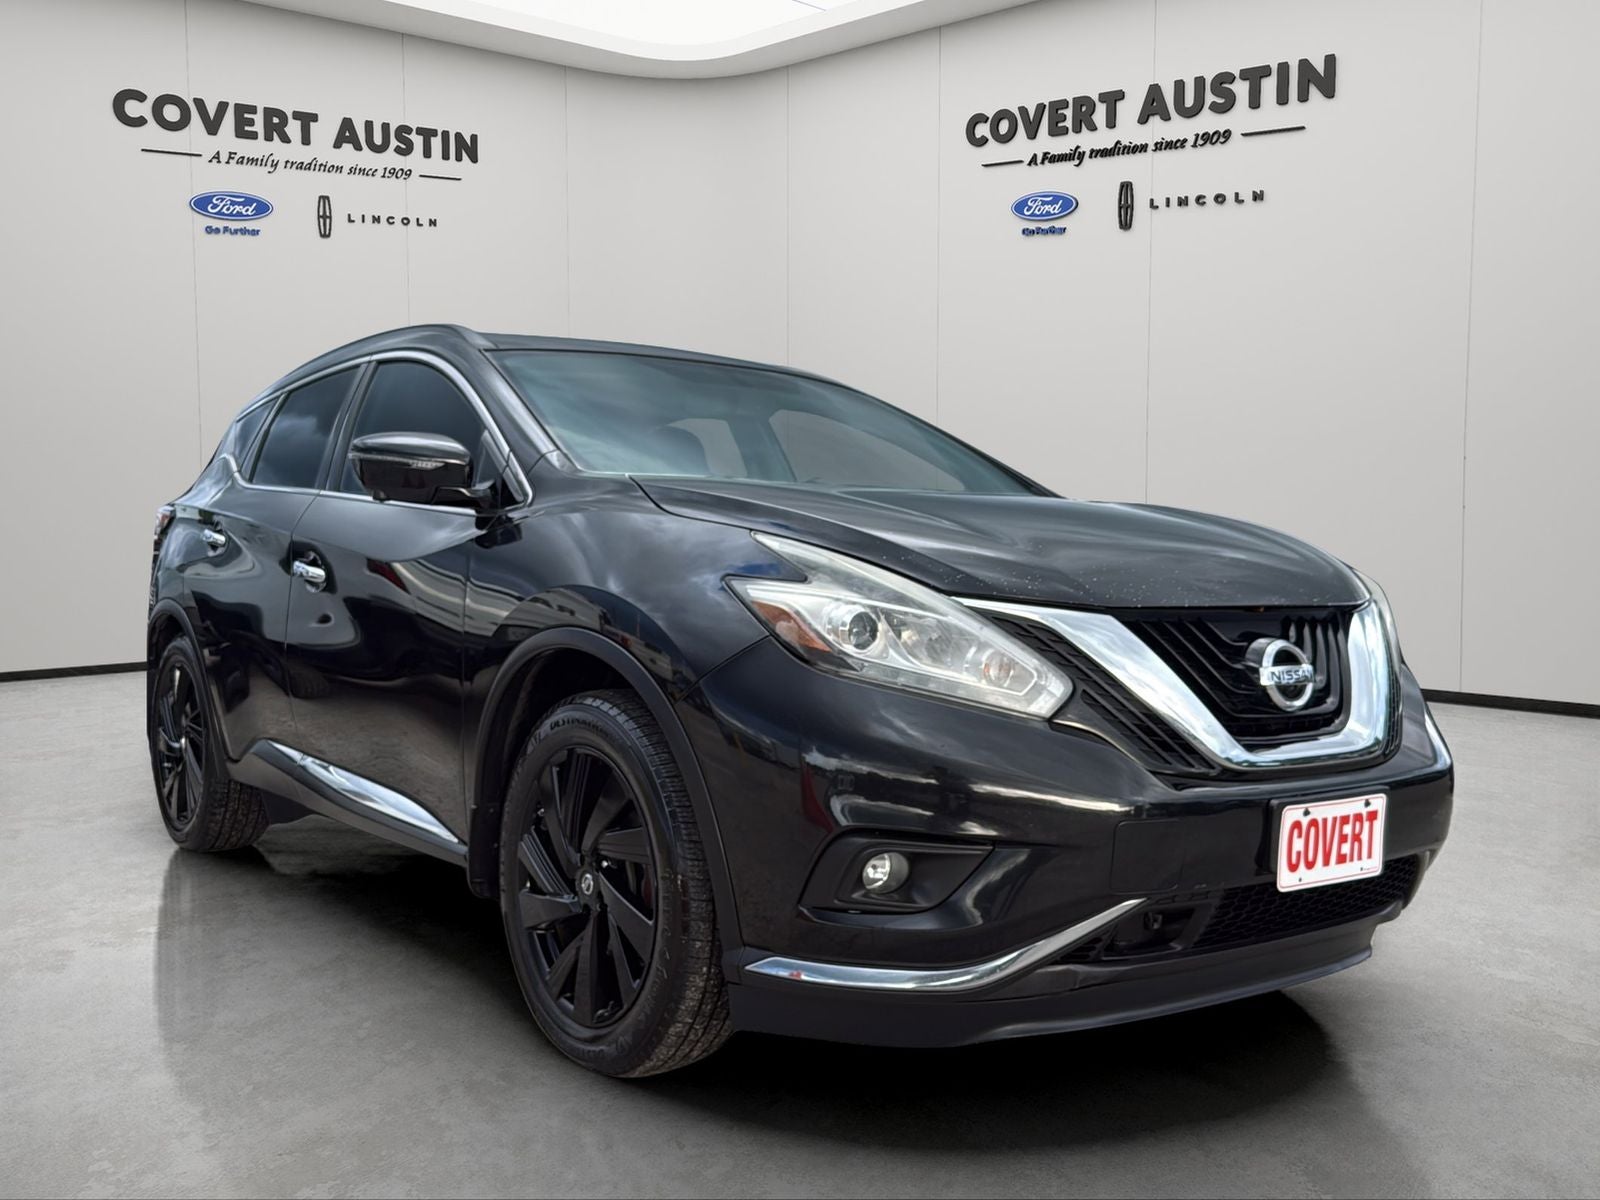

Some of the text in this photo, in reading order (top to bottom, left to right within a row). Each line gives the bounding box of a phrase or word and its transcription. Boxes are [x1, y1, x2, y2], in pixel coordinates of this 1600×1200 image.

[965, 53, 1337, 148] COVERT AUSTIN
[112, 88, 479, 164] COVERT AUSTIN
[1027, 128, 1232, 168] A Family tradition since 1909
[208, 150, 413, 180] A Family tradition since 1909
[207, 195, 257, 216] Ford
[1023, 196, 1063, 216] Ford
[1149, 190, 1265, 210] LINCOLN
[347, 213, 437, 228] LINCOLN
[1286, 809, 1379, 873] COVERT
